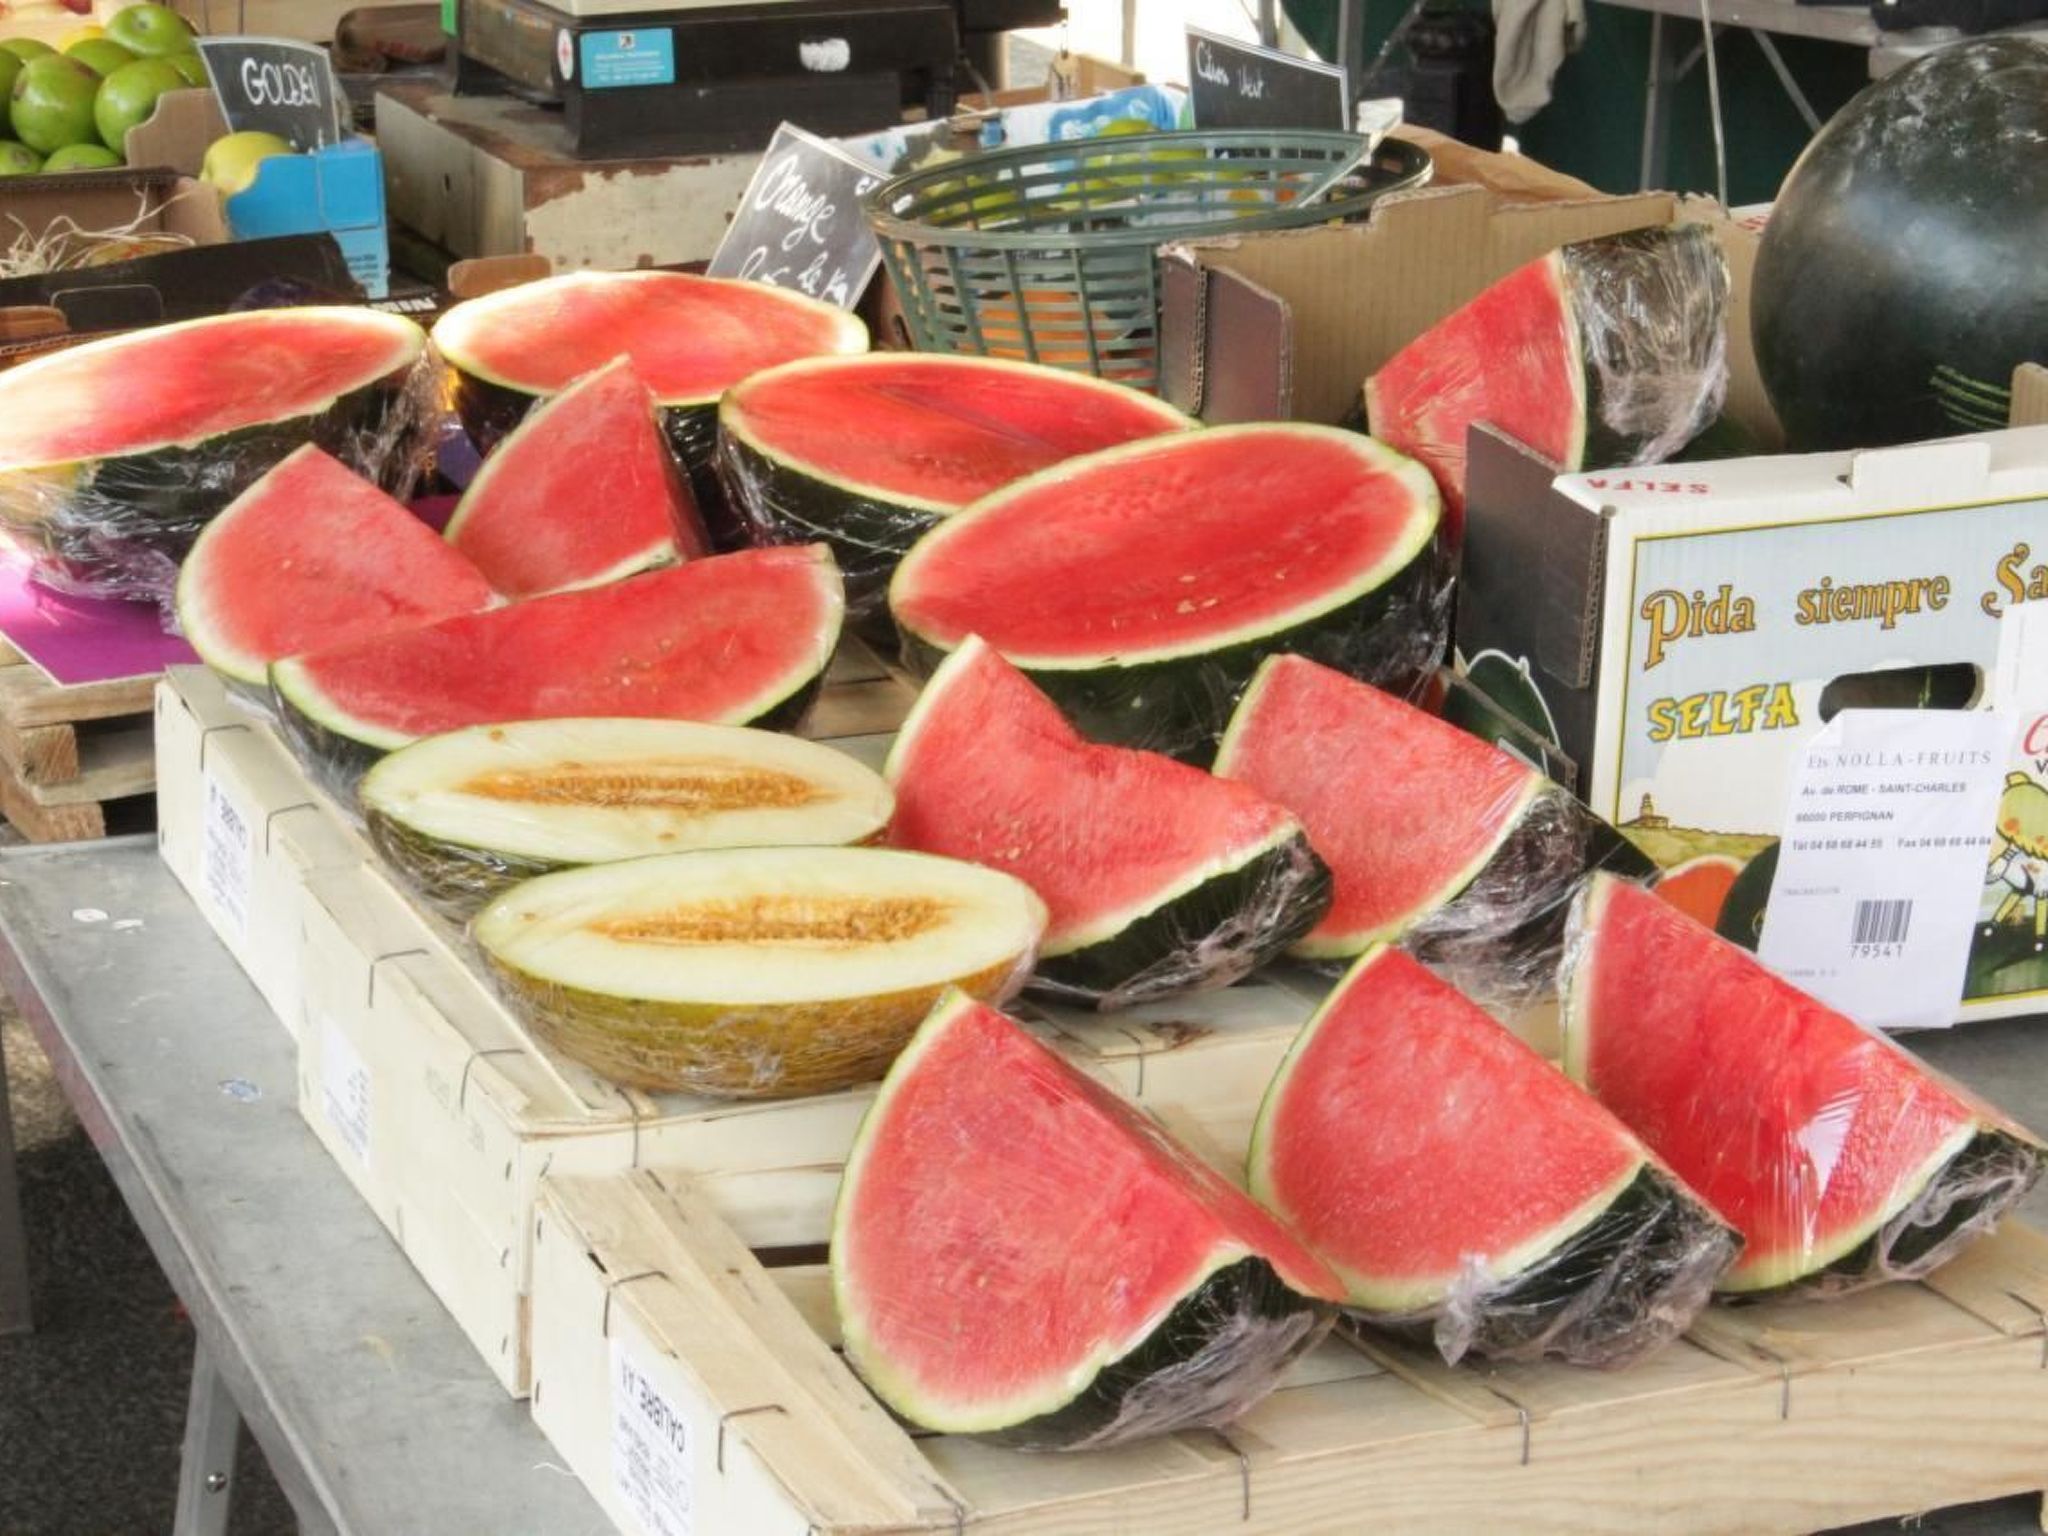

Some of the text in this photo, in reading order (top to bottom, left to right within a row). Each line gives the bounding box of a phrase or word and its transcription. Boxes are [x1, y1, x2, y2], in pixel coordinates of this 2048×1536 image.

[241, 57, 322, 107] GOLDEN
[754, 153, 837, 252] Orange
[1586, 478, 1709, 494] SELFA
[1640, 583, 1756, 671] Pida
[1795, 575, 1951, 630] siempre
[1647, 682, 1800, 743] SELFA
[1836, 750, 1992, 767] NOLLA-FRUITS
[1837, 783, 1869, 795] ROME
[1879, 782, 1967, 794] SAINT-CHARLES
[1829, 811, 1894, 822] PERPIGNAN
[1851, 945, 1903, 958] 79541
